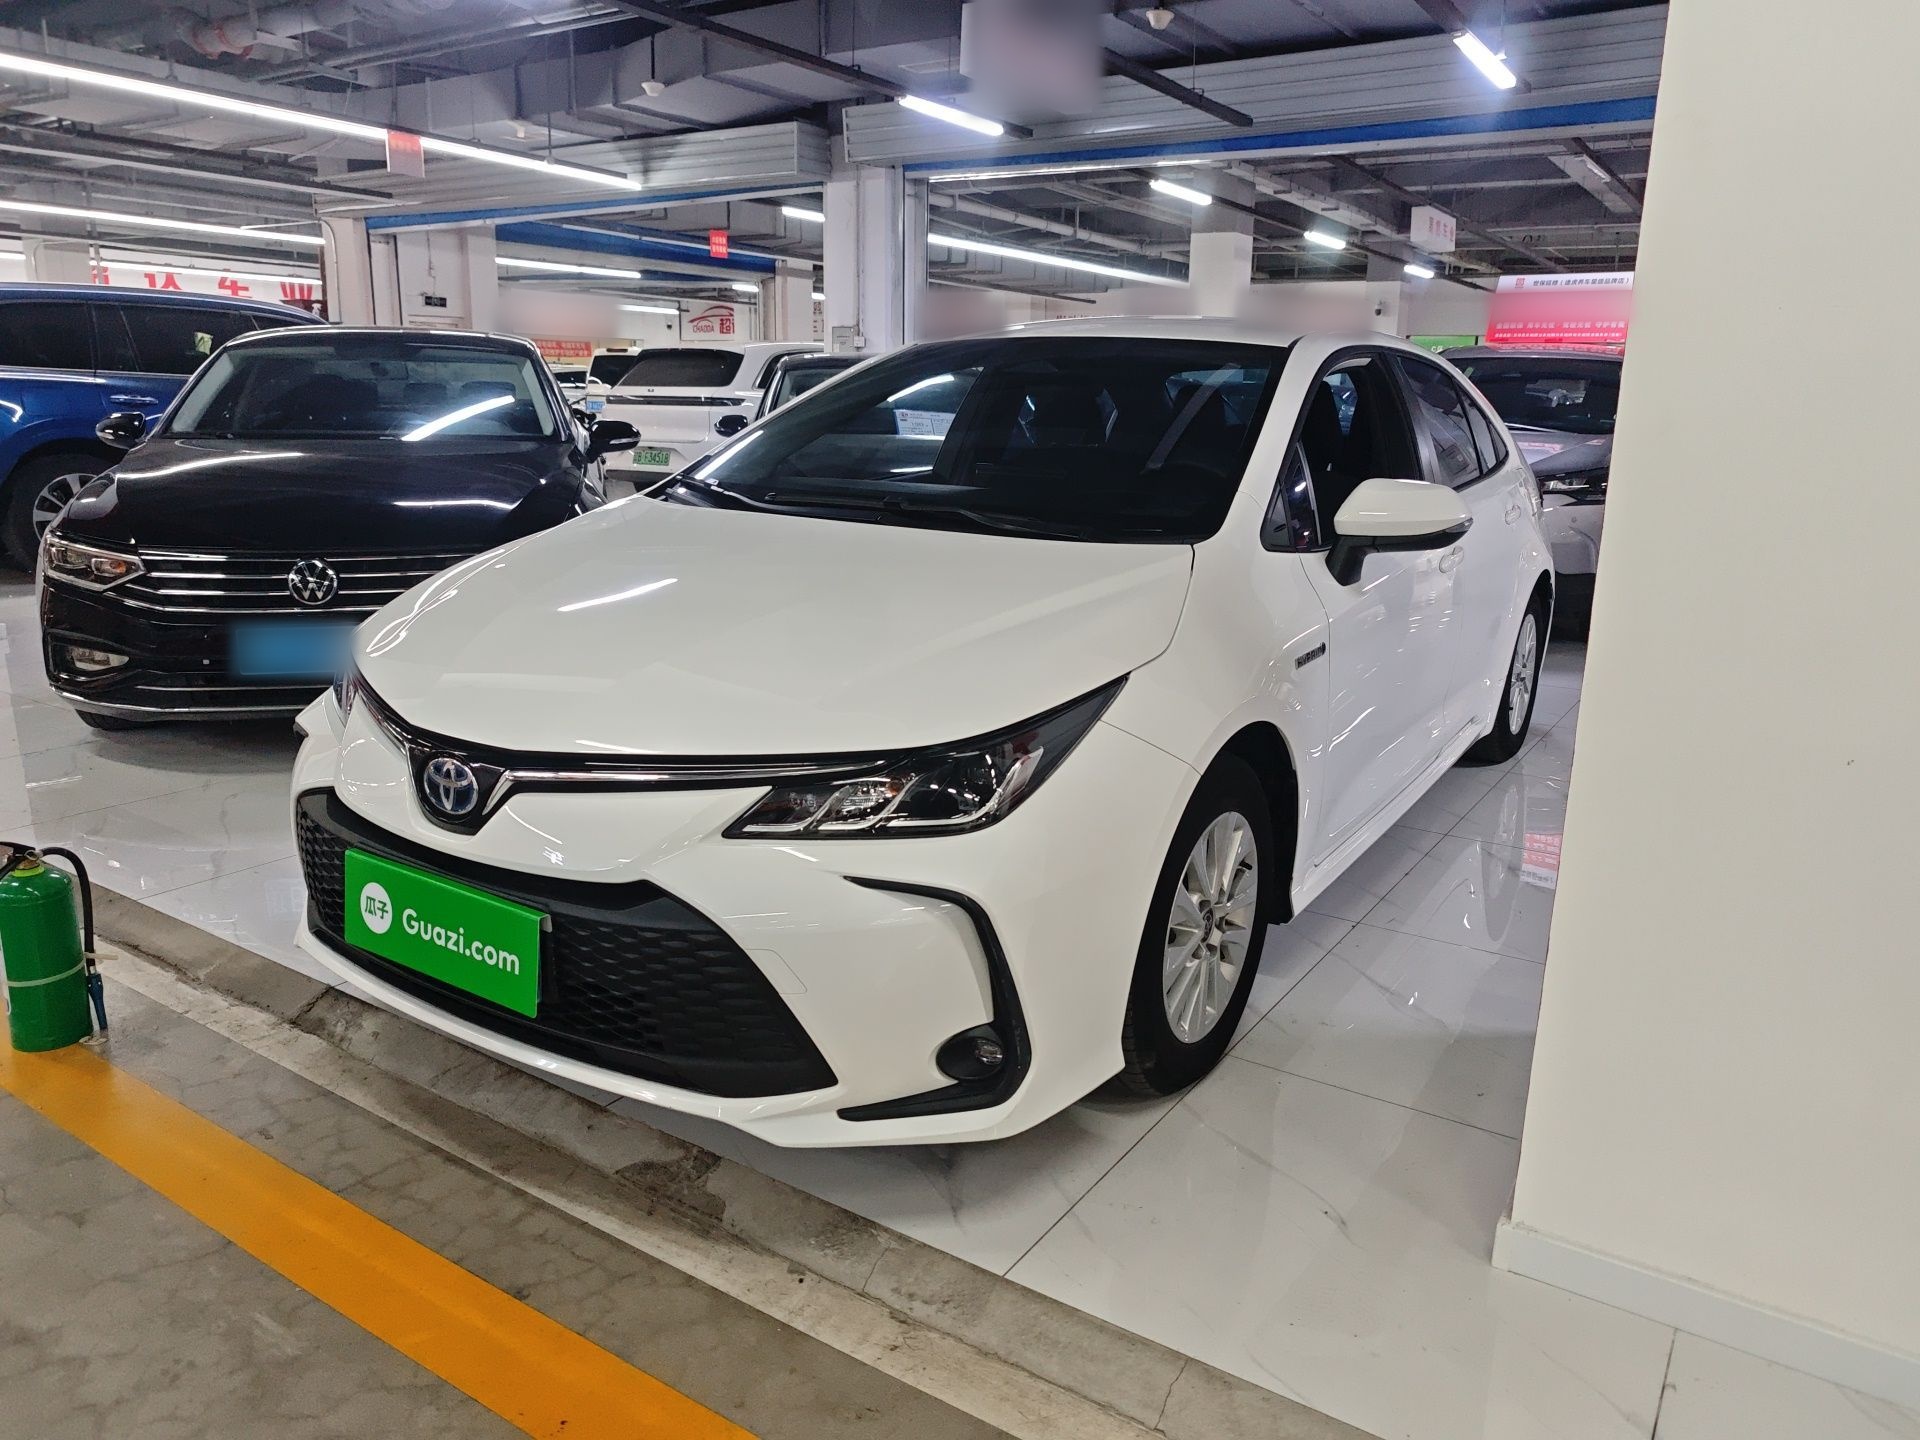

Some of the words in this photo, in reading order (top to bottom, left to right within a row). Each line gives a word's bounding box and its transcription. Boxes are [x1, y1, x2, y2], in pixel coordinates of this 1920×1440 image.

[719, 318, 735, 335] 超
[364, 895, 389, 921] 瓜子
[402, 908, 520, 976] Guazi.com
